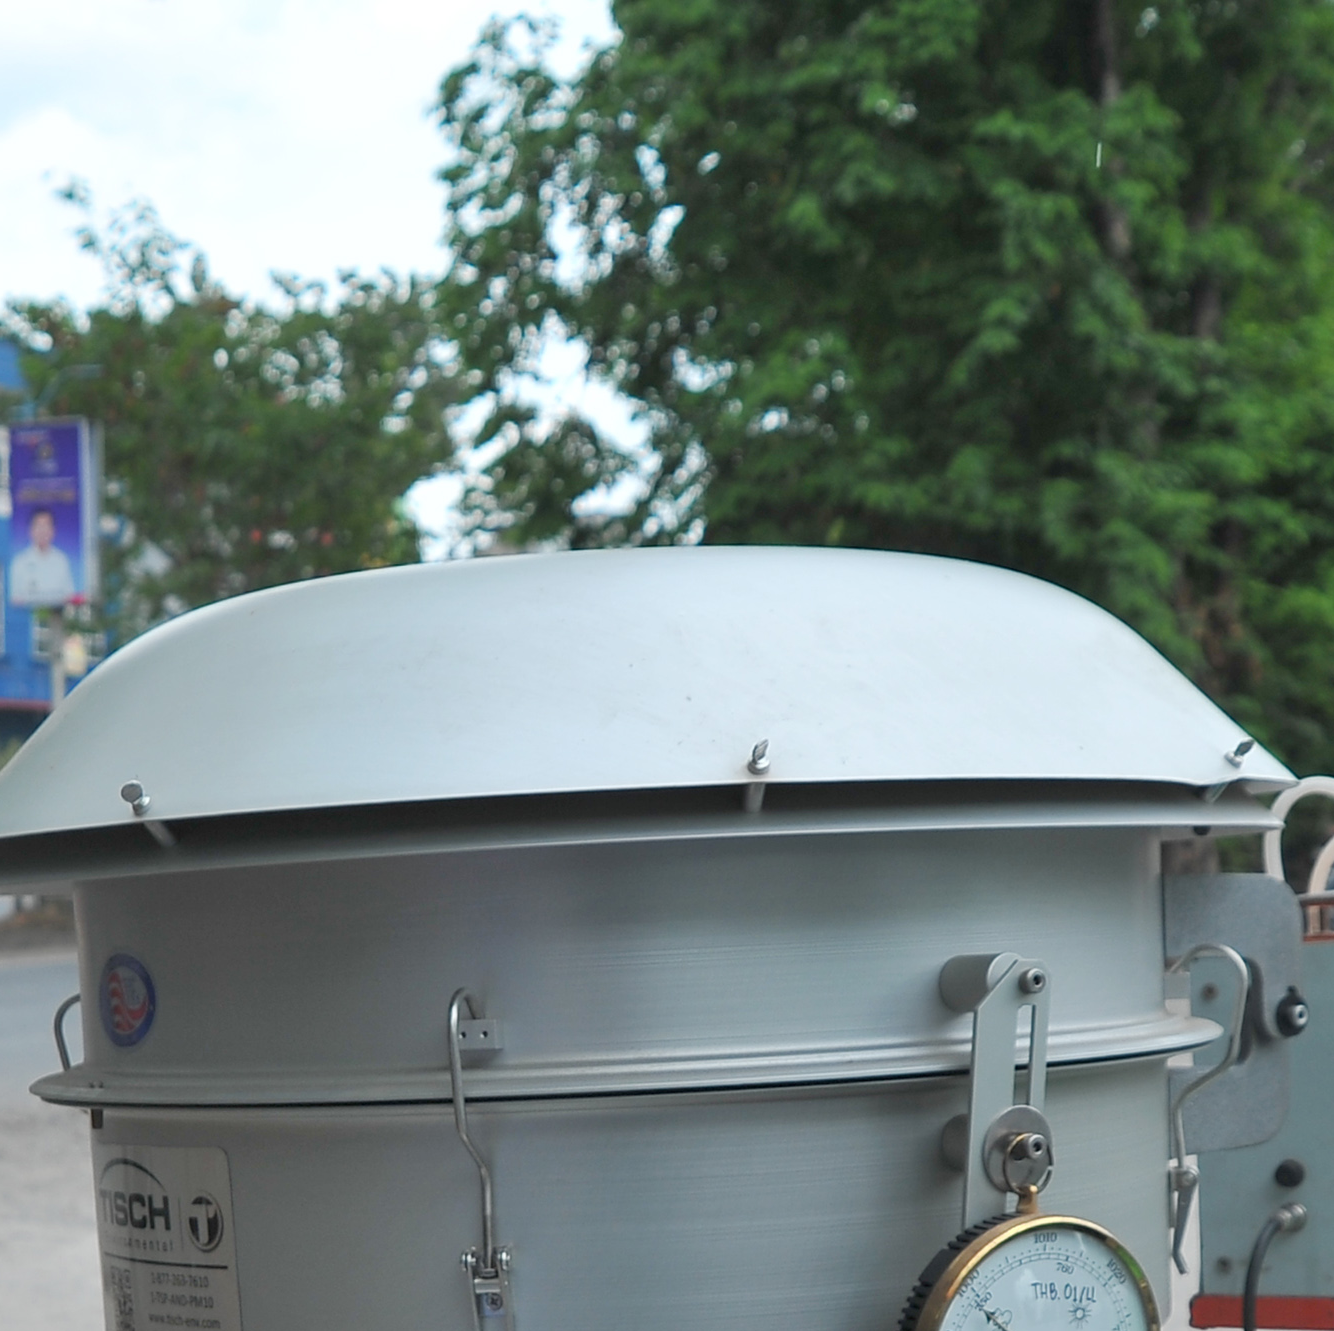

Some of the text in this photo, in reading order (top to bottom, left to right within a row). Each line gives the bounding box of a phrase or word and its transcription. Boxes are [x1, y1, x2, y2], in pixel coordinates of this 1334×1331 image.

[99, 1189, 171, 1231] TISCH
[1033, 1233, 1058, 1244] 1010
[1105, 1258, 1127, 1285] 1020
